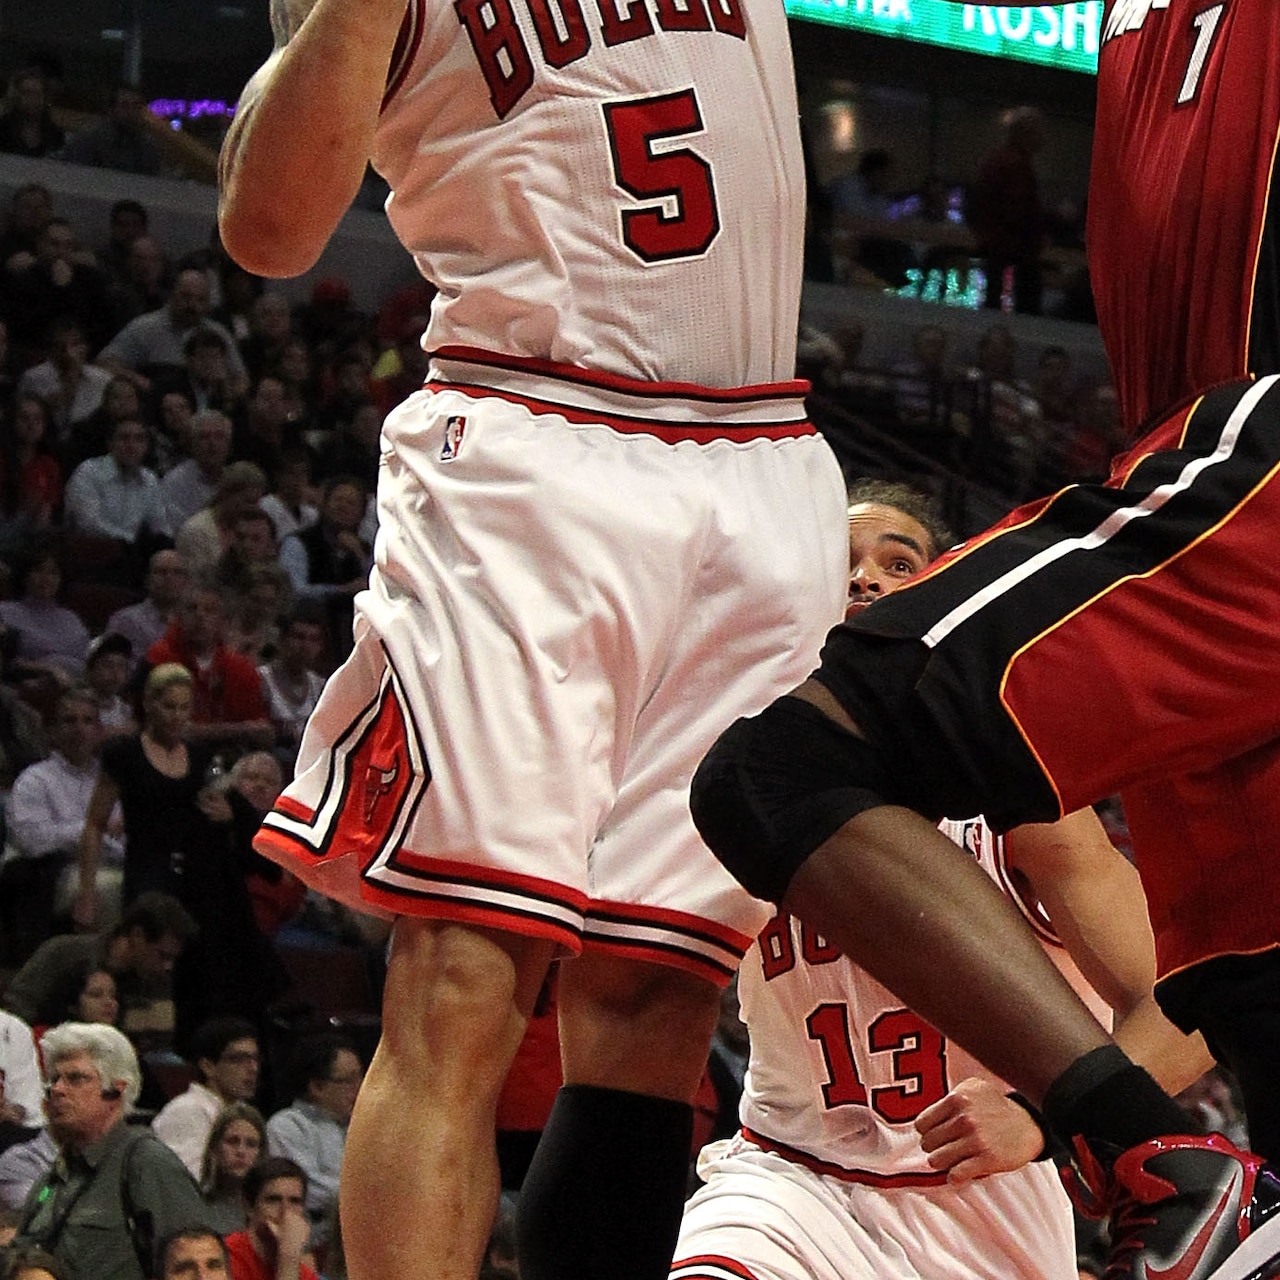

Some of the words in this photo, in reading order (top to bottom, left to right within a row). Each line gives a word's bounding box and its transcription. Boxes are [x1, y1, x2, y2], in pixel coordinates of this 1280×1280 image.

[1173, 1, 1229, 108] 1
[600, 86, 725, 268] 5
[805, 1002, 949, 1125] 13
